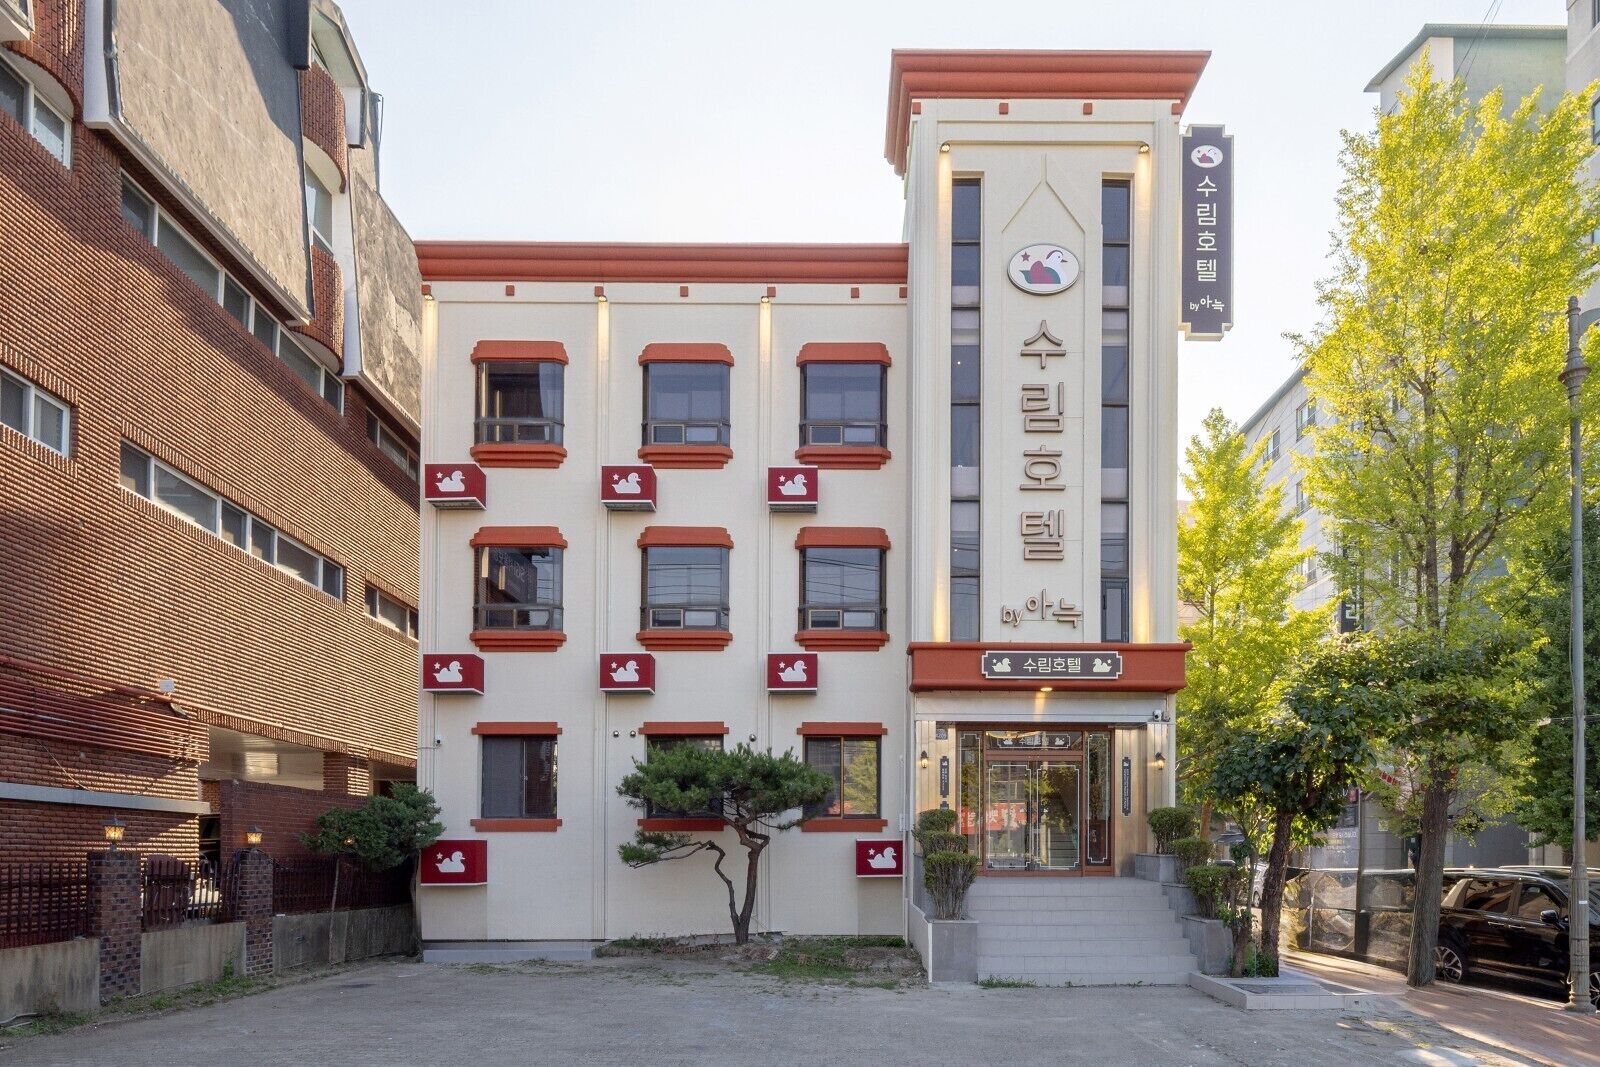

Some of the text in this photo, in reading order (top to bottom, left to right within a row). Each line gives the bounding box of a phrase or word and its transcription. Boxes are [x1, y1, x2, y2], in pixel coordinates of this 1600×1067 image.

[1196, 175, 1217, 282] 수림호텔
[1189, 295, 1225, 312] by 아늑
[1020, 319, 1067, 561] 수림호텔
[1001, 589, 1083, 628] by 아늑
[1023, 657, 1081, 673] 수림호텔
